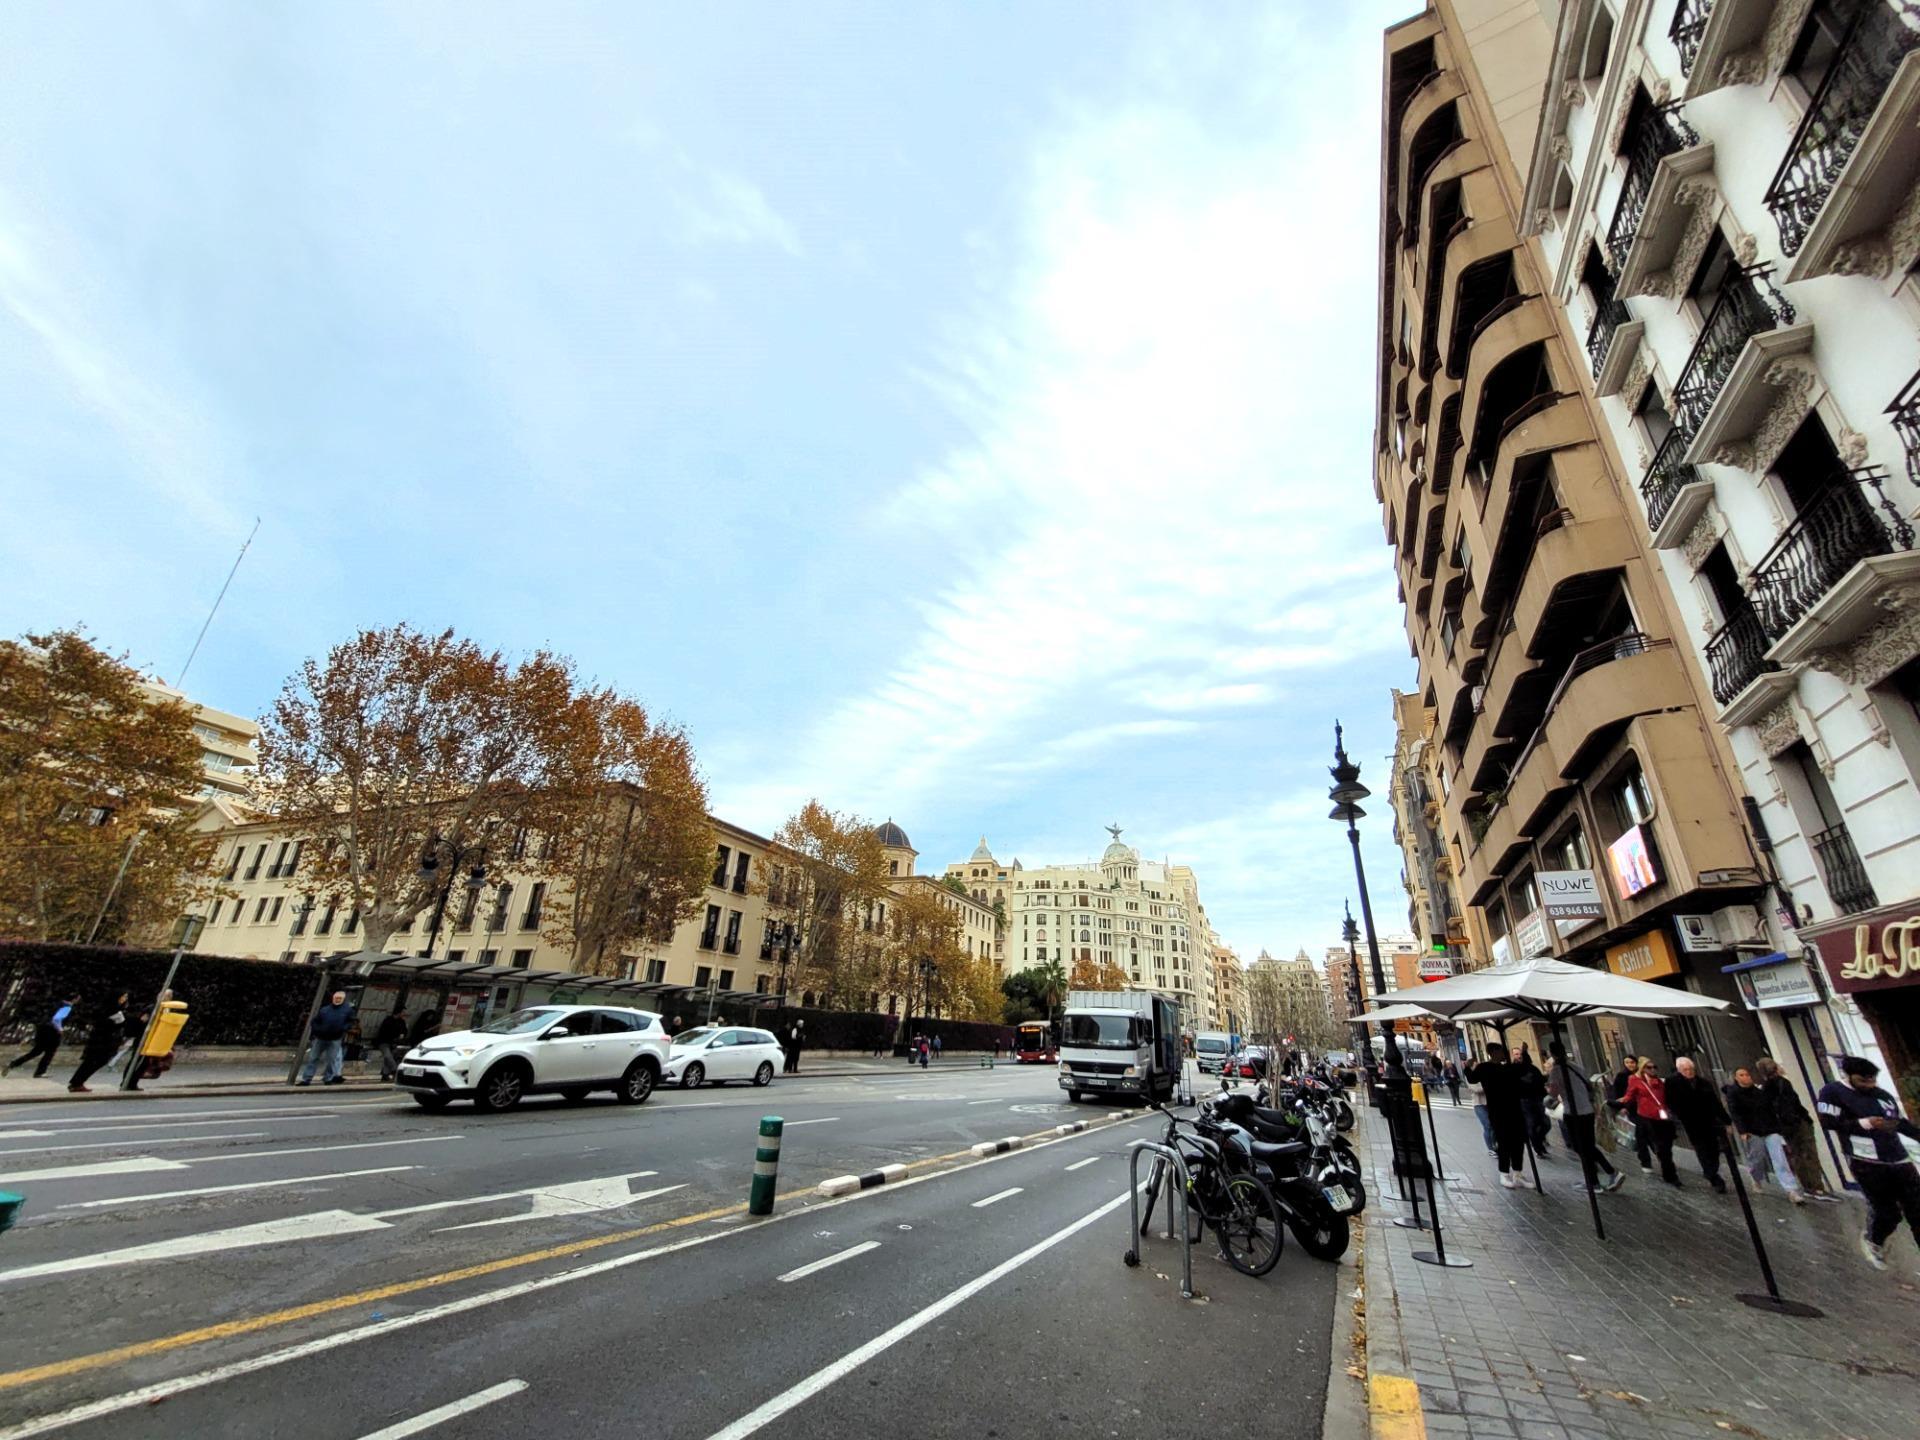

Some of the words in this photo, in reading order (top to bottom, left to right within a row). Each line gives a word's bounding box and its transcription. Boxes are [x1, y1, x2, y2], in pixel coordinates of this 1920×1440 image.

[1542, 878, 1594, 892] NUWE
[1549, 907, 1565, 916] 638
[1566, 906, 1582, 916] 946
[1583, 905, 1600, 915] 814
[1840, 924, 1882, 979] La
